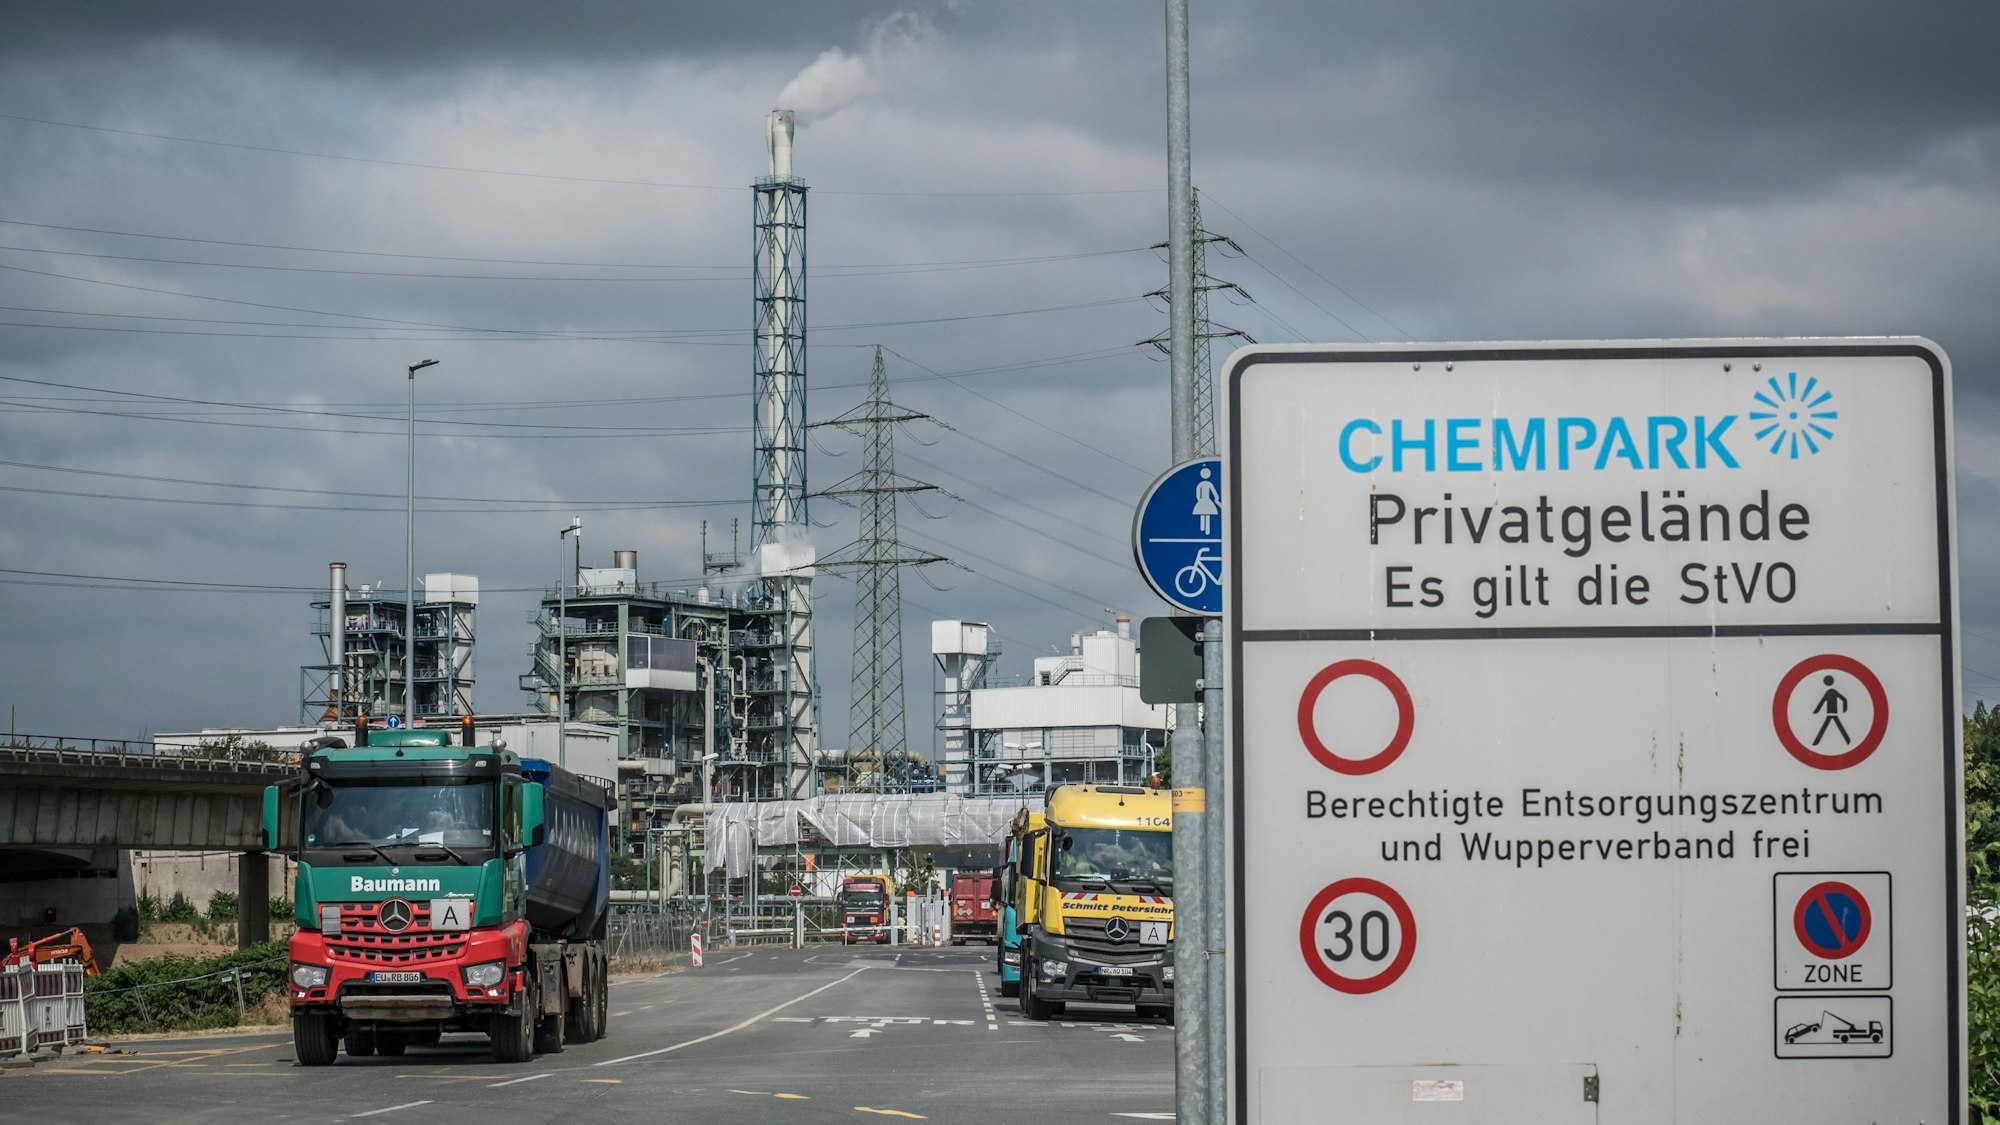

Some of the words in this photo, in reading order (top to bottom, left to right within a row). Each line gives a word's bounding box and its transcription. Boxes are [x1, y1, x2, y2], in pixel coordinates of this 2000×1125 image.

[1339, 416, 1740, 473] CHEMPARK
[1370, 490, 1811, 558] Privatgelände
[1386, 566, 1445, 608] Es
[1473, 564, 1549, 618] gilt
[1578, 563, 1651, 606] die
[1680, 562, 1797, 605] StVO
[1306, 790, 1504, 826] Berechtigte
[1522, 787, 1883, 825] Entsorgungszentrum
[1381, 832, 1441, 862] und
[1461, 829, 1734, 869] Wupperverband
[1753, 829, 1810, 859] frei
[351, 875, 441, 892] Baumann
[442, 905, 459, 926] A
[1062, 902, 1109, 912] Schmitt
[1111, 904, 1175, 914] Peterslahr
[1147, 926, 1160, 942] A
[1322, 910, 1390, 963] 30
[375, 973, 387, 982] EU
[391, 973, 403, 982] RB
[1804, 964, 1863, 983] ZONE
